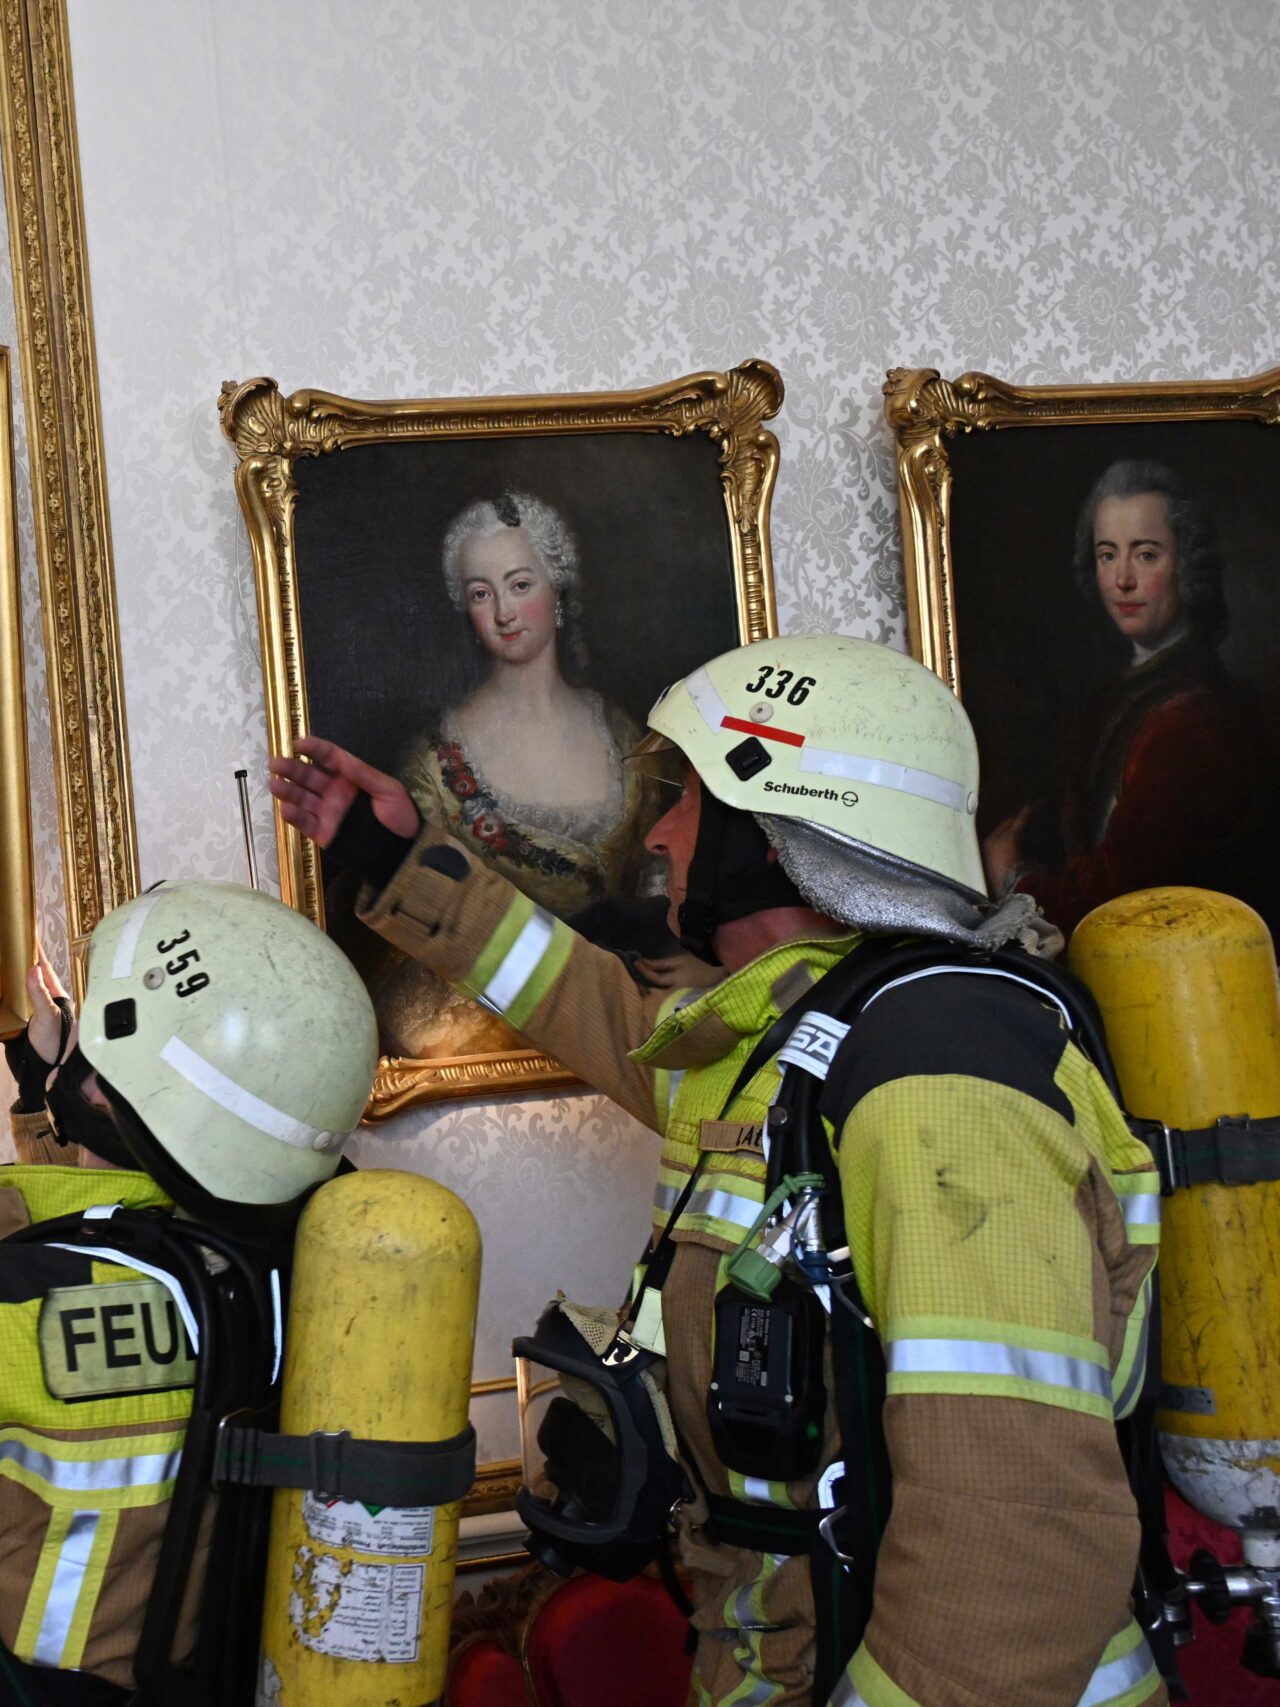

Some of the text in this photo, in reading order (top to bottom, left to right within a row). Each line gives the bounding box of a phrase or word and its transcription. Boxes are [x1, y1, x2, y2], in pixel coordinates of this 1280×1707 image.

[746, 666, 816, 706] 336
[763, 781, 839, 801] Schuberth
[157, 929, 210, 998] 359
[59, 1300, 197, 1372] FEU
